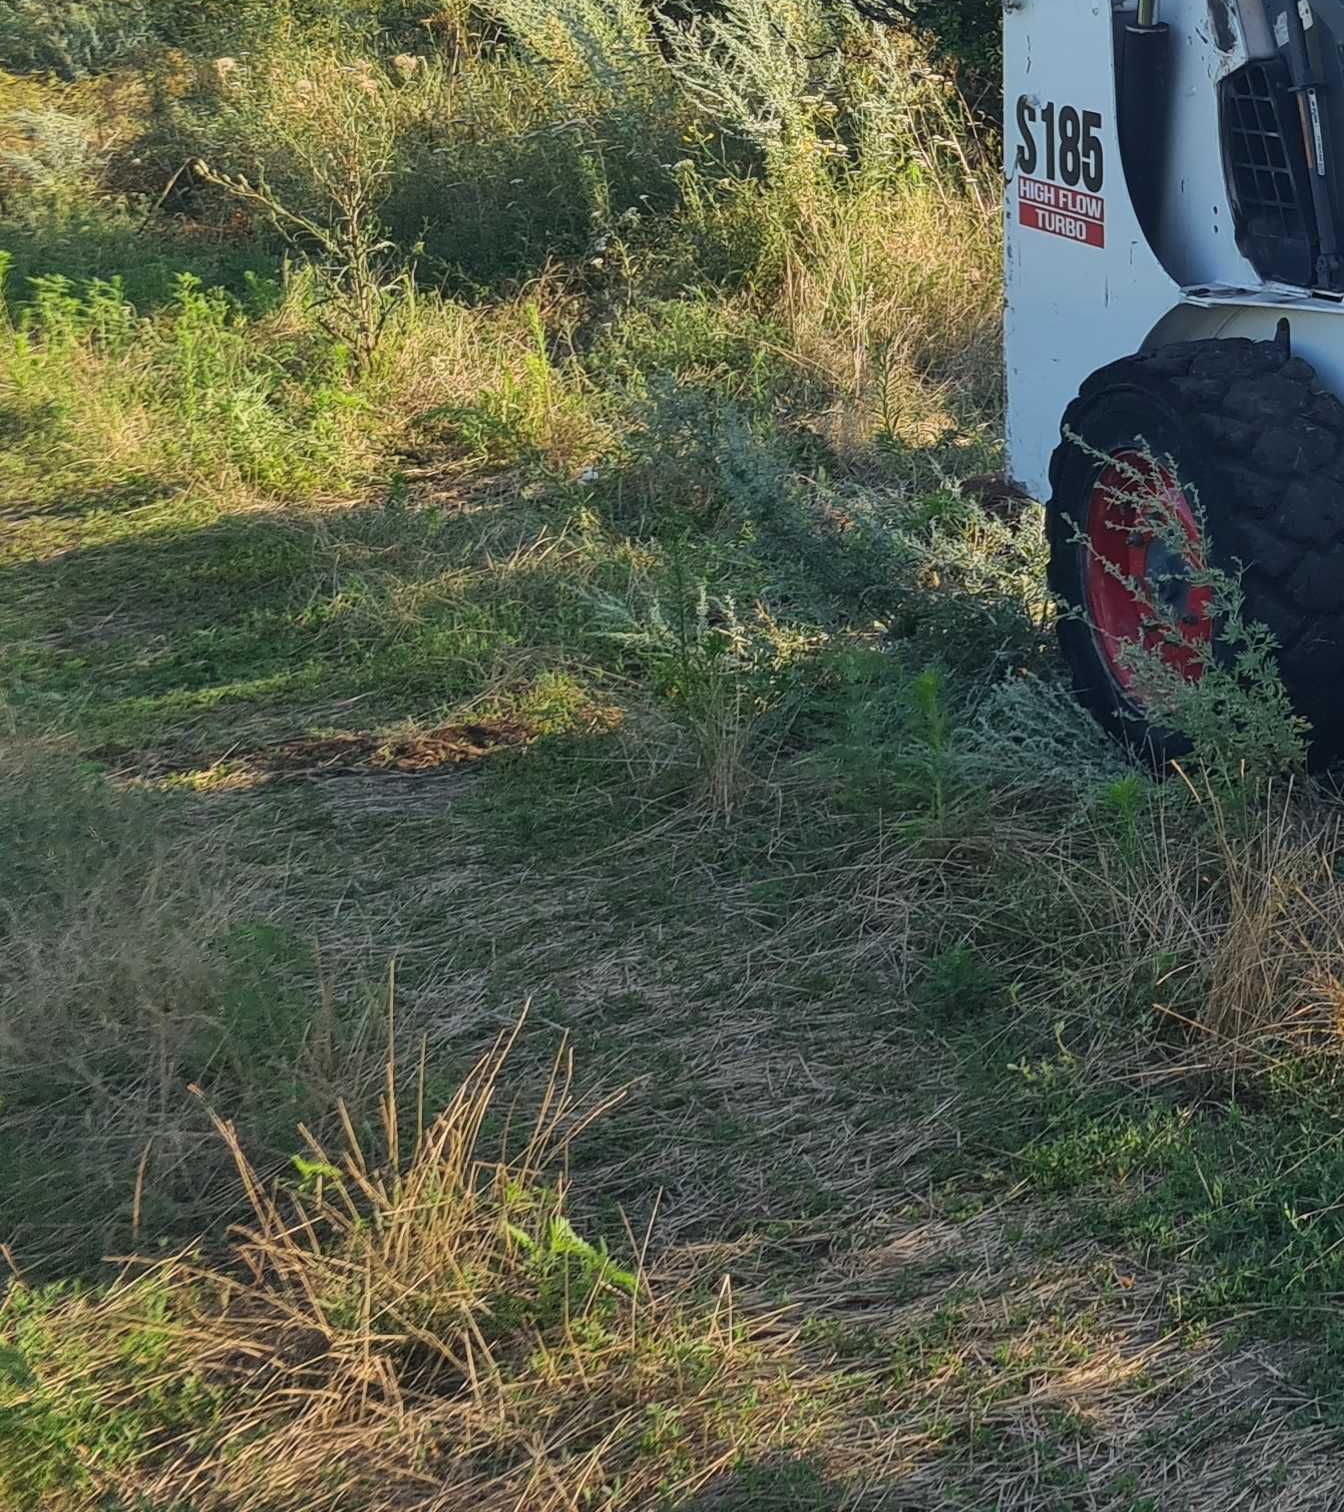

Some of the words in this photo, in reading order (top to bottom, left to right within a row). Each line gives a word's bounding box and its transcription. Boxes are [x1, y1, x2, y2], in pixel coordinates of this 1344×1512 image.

[1016, 94, 1104, 193] S185
[1019, 178, 1055, 206] HIGH
[1059, 189, 1101, 218] FLOW
[1035, 208, 1087, 240] TURBO
